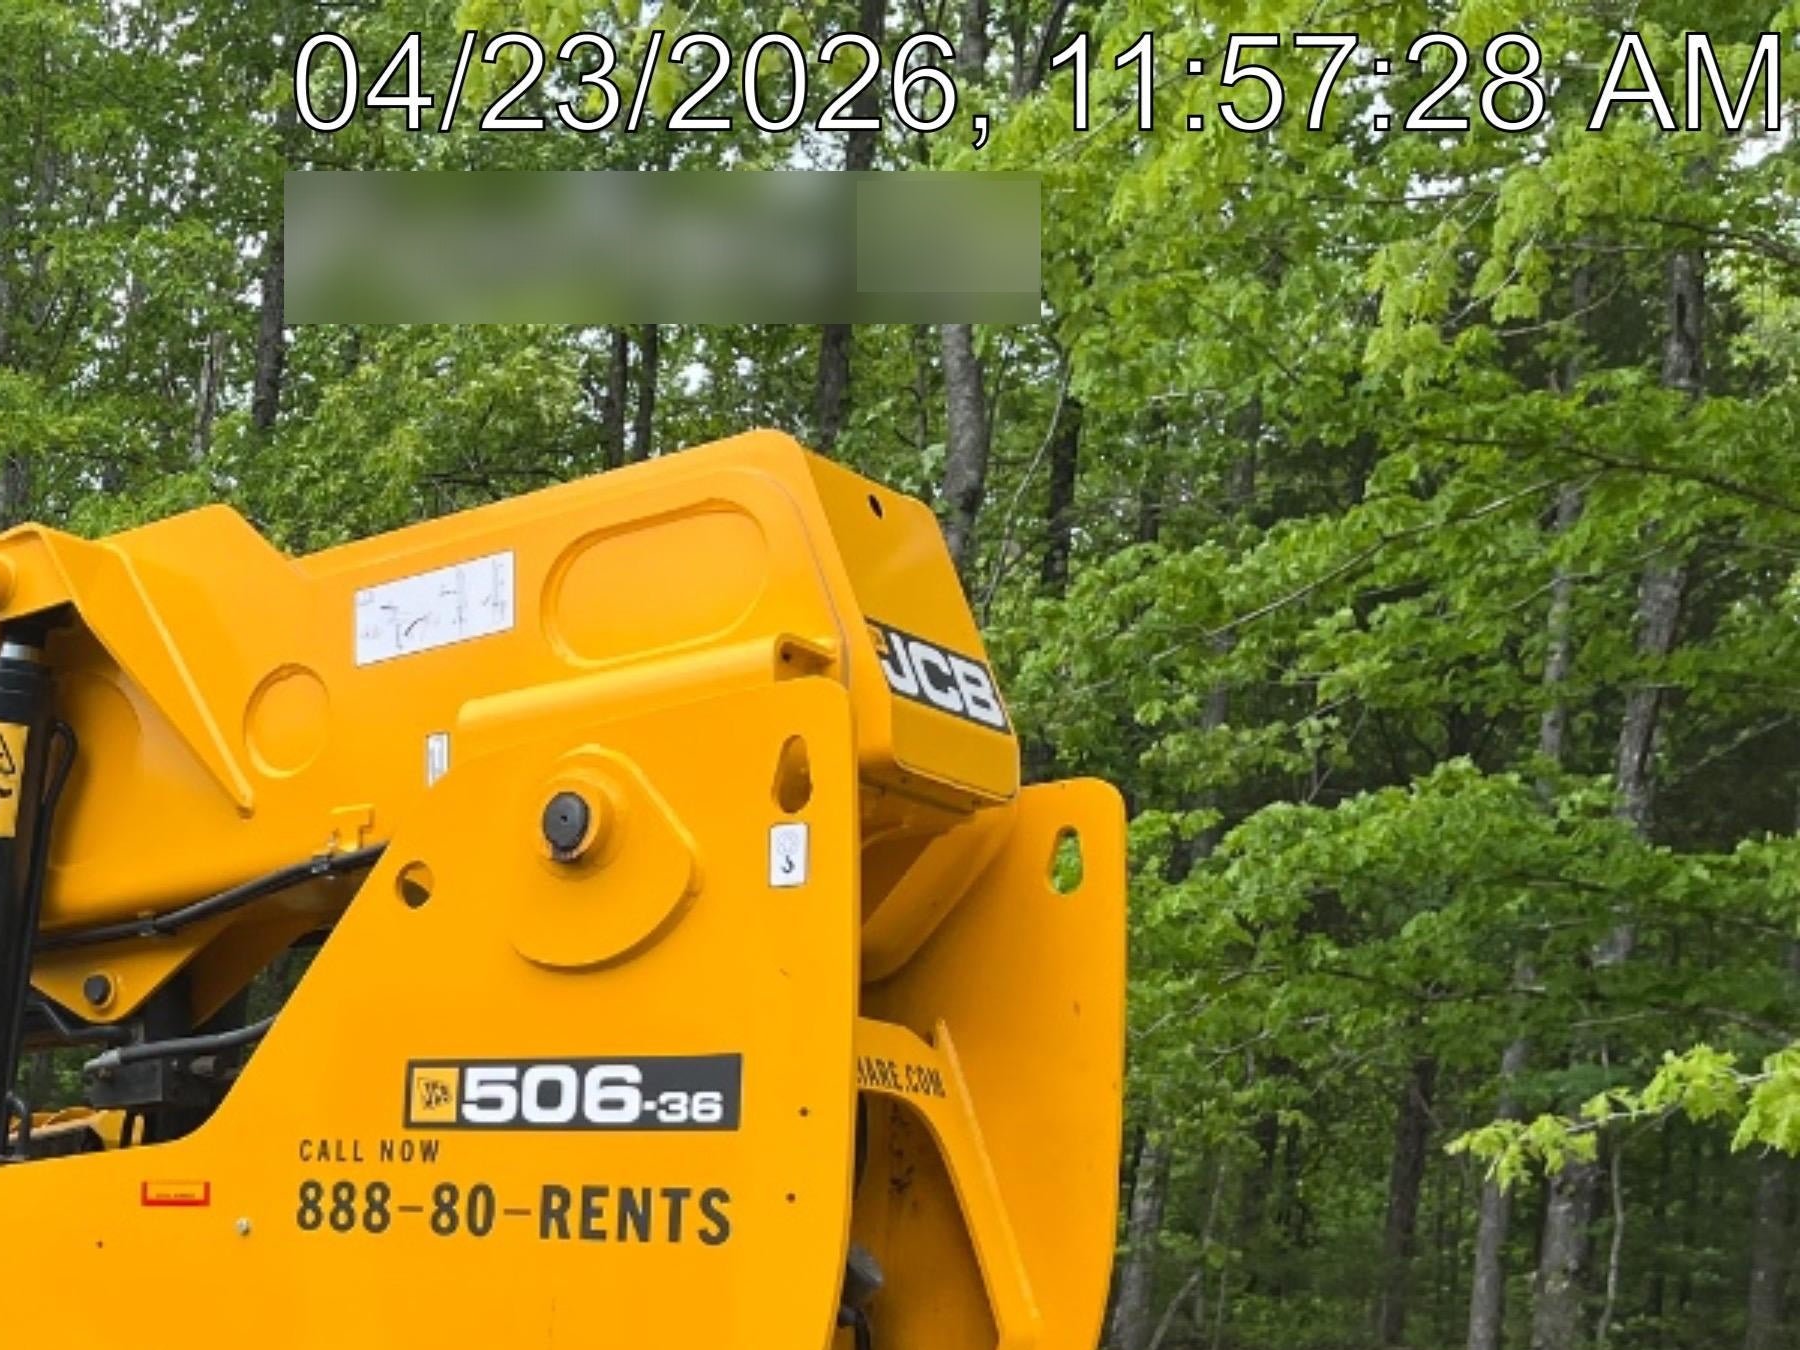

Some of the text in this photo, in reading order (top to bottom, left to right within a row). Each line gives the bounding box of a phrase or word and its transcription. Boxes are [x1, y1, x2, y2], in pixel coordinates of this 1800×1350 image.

[882, 631, 1006, 729] JCB
[460, 1063, 725, 1124] 506-36
[299, 1140, 440, 1163] CALL NOW
[296, 1180, 731, 1246] 888-80-RENTS
